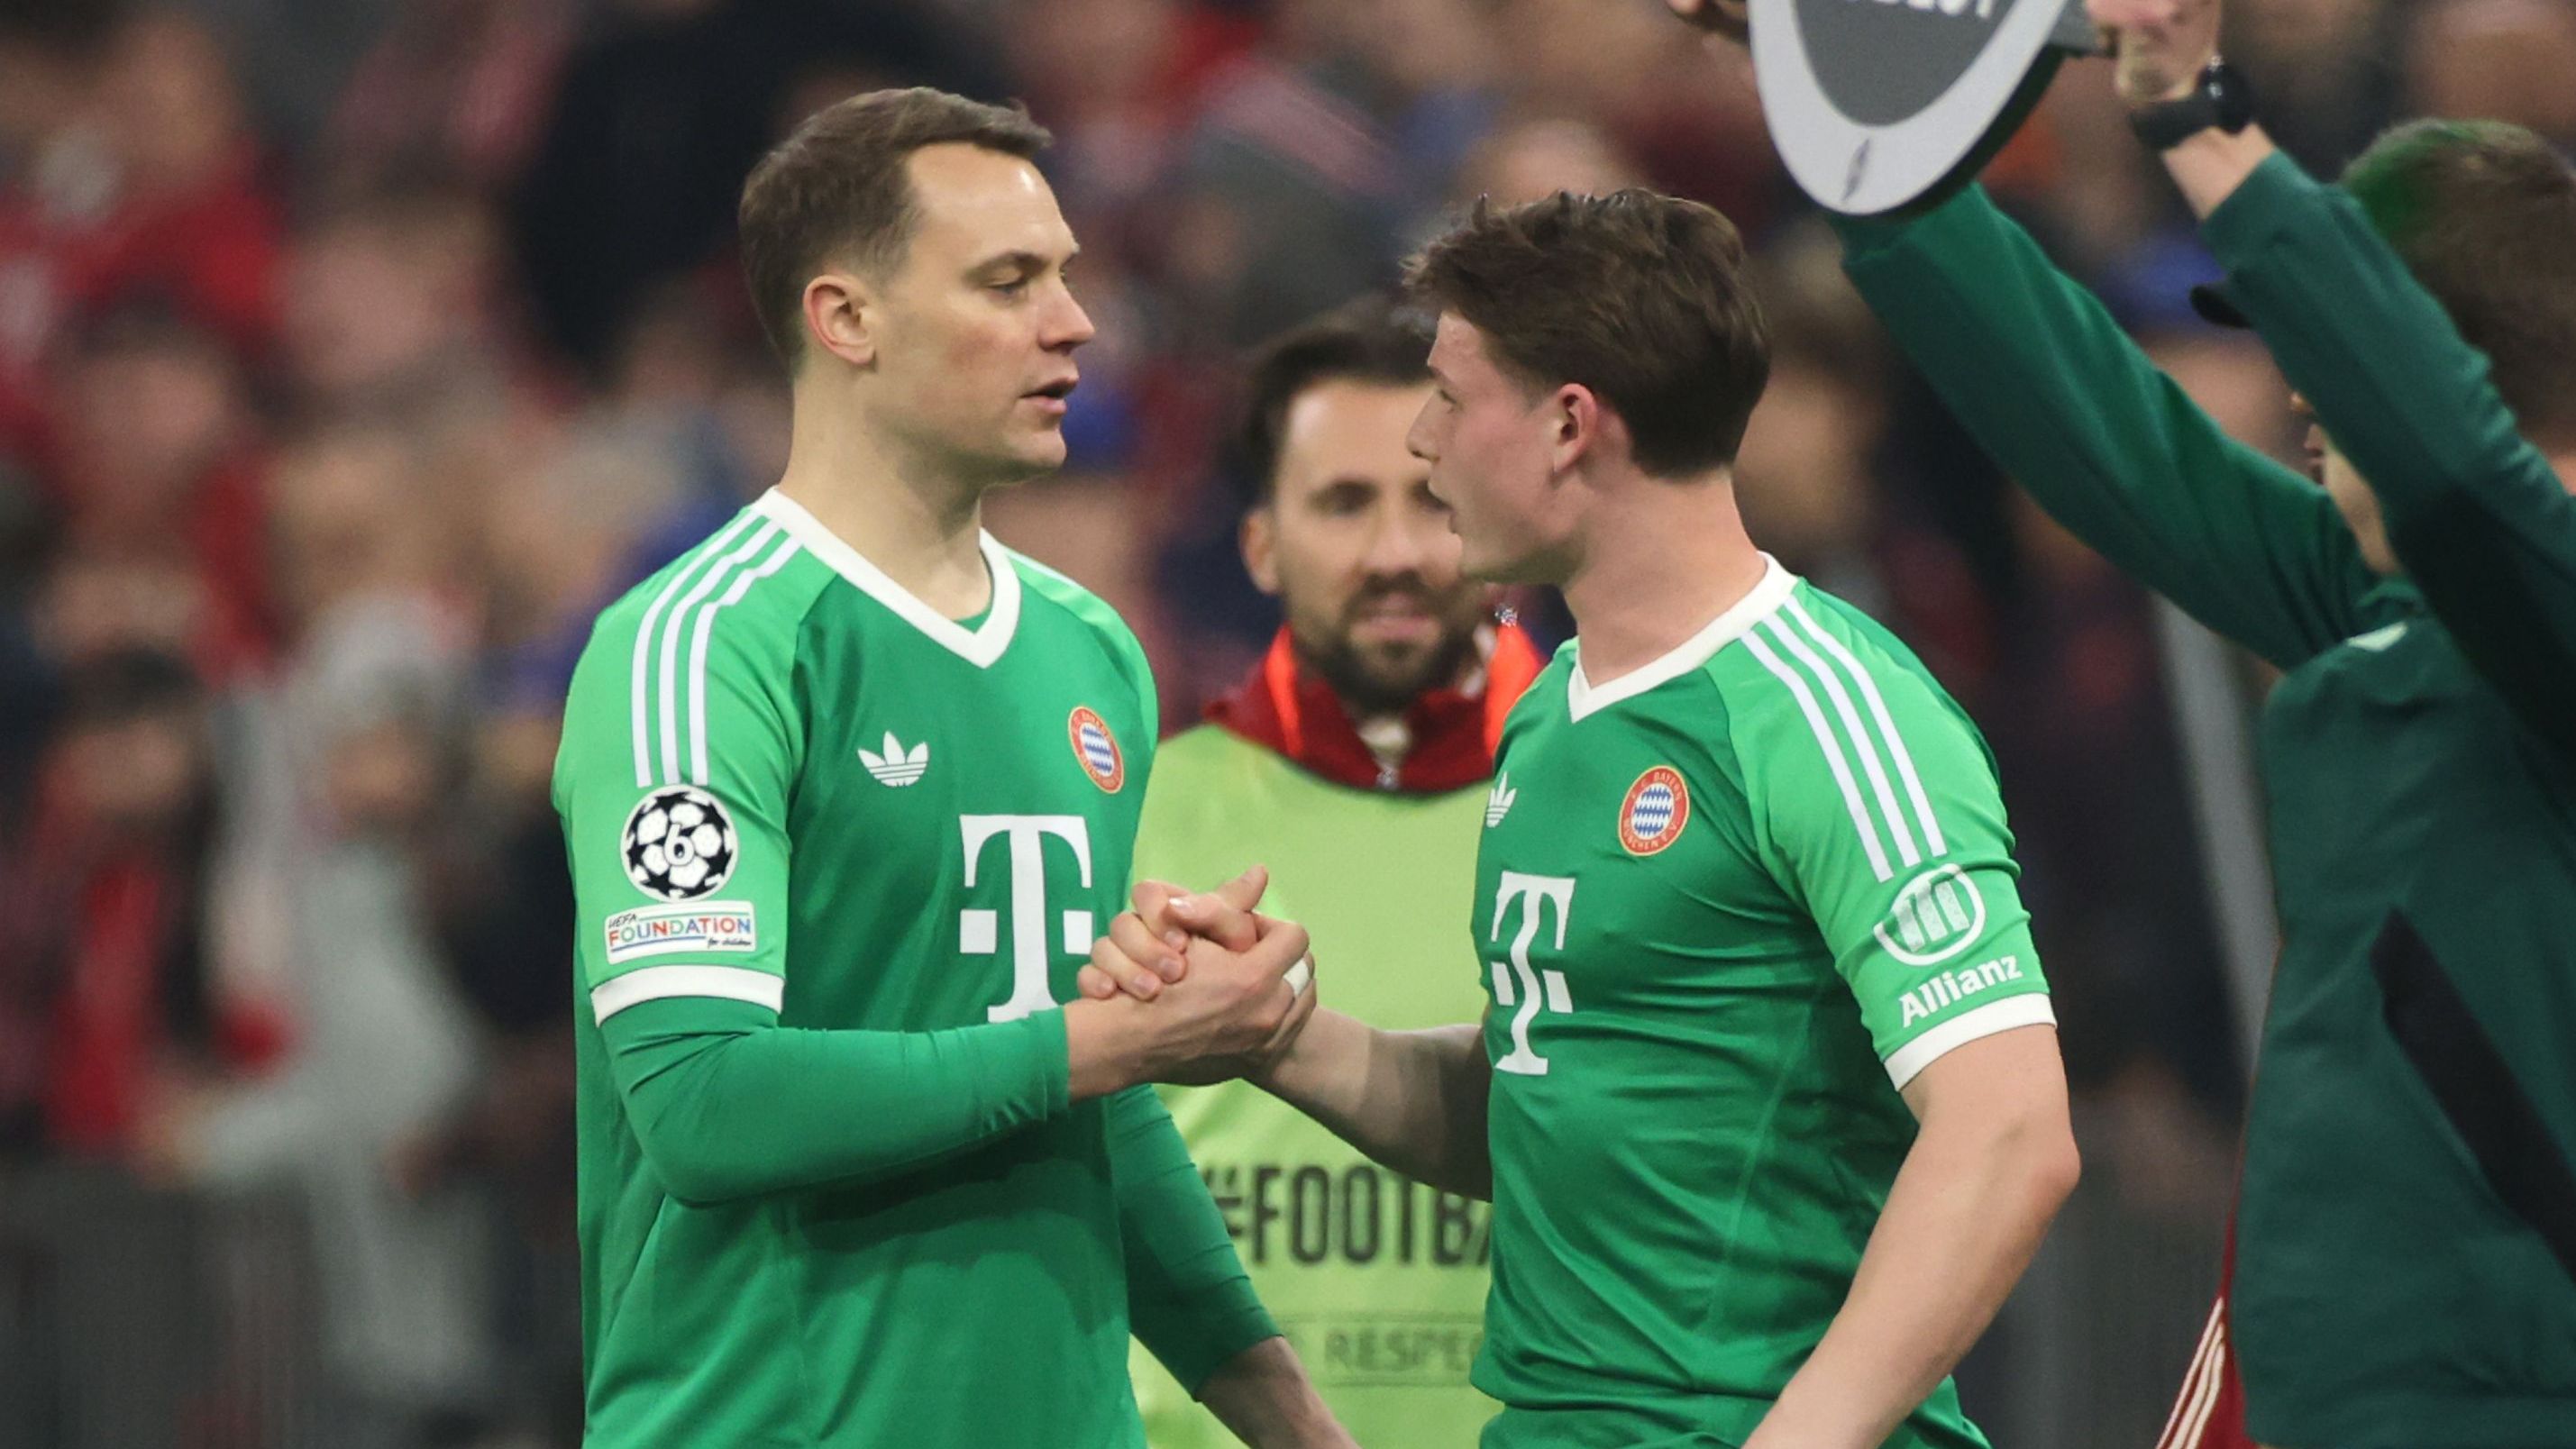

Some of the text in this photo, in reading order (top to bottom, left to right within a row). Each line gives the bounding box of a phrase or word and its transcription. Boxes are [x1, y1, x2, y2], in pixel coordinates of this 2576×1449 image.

[663, 822, 695, 867] 6
[607, 916, 751, 947] FOUNDATION
[608, 913, 638, 929] UEFA
[959, 814, 1092, 1024] T
[1898, 954, 2023, 1029] Allianz
